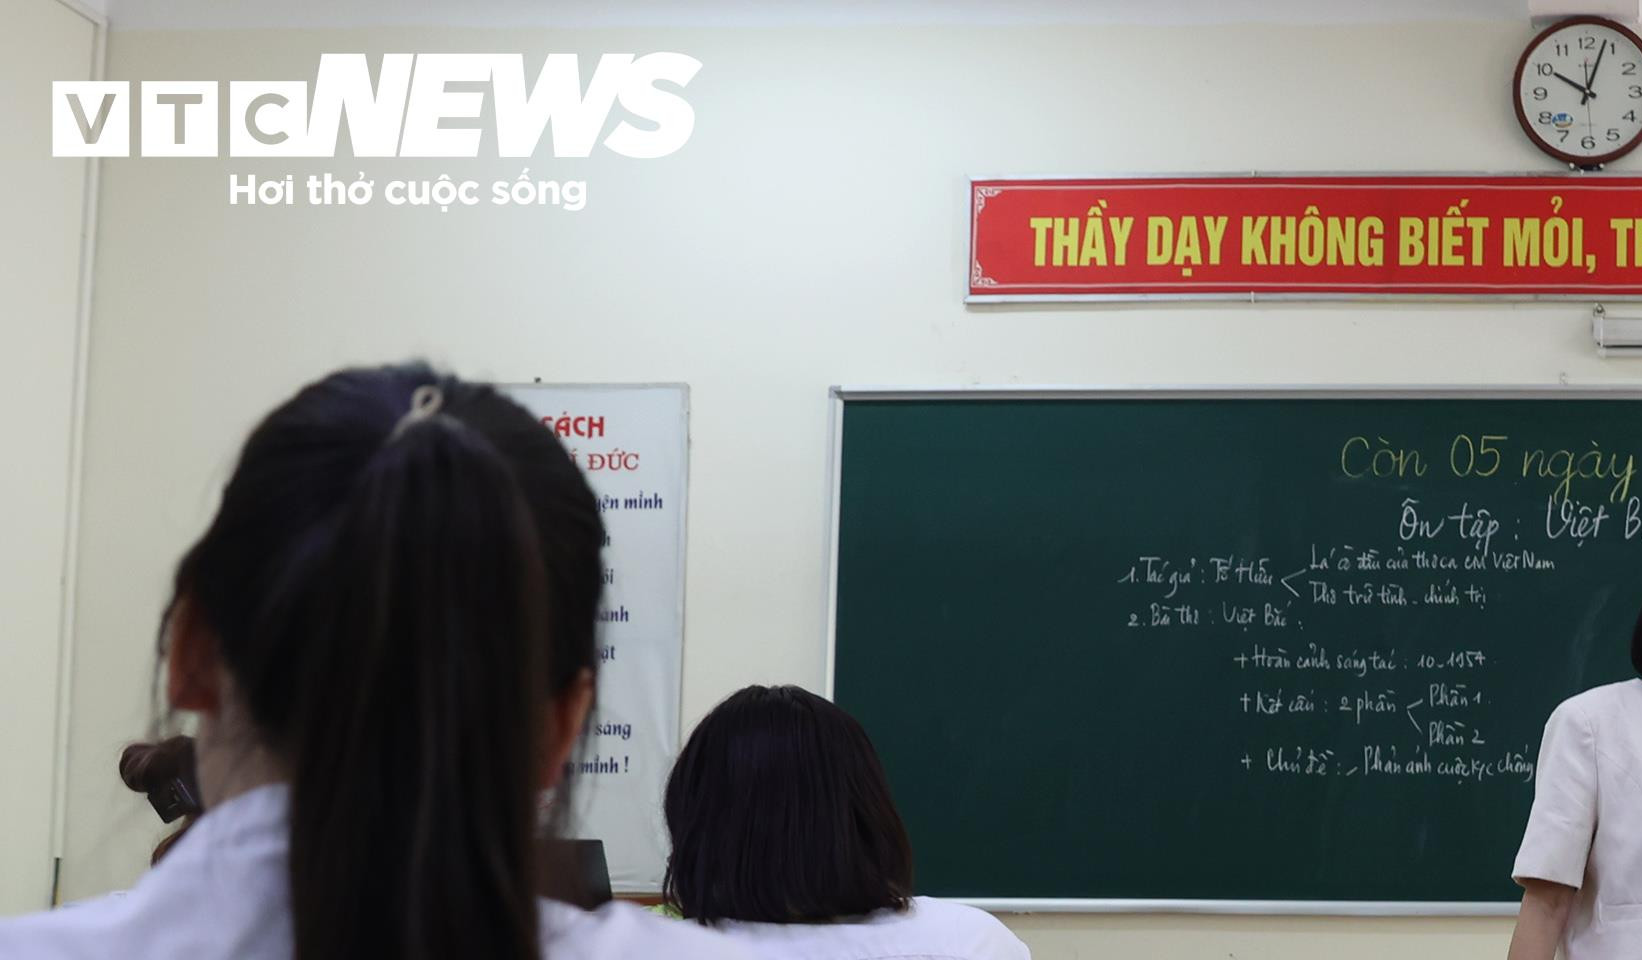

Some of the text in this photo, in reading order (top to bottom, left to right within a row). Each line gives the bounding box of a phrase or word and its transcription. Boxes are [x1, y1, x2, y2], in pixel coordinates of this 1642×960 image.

[1556, 44, 1569, 57] 11
[1578, 36, 1596, 50] 12
[1609, 42, 1616, 55] 1
[1536, 62, 1554, 77] 10
[1621, 62, 1637, 76] 2
[1532, 86, 1548, 101] 9
[1538, 111, 1552, 125] 8
[1621, 109, 1637, 123] 4
[1556, 129, 1570, 143] 7
[1580, 135, 1597, 150] 6
[1606, 128, 1621, 142] 5
[1030, 199, 1134, 267] THẦY
[1147, 215, 1228, 277] DẠY
[1241, 205, 1385, 267] KHÔNG
[1399, 198, 1490, 267] BIẾT
[1503, 195, 1597, 274] MỎI,
[587, 448, 640, 472] ĐỨC
[1342, 436, 1428, 479] Còn
[1450, 434, 1508, 478] 05
[1521, 440, 1637, 503] ngày
[1399, 497, 1444, 542] Ôn
[1448, 502, 1500, 555] tập
[1546, 494, 1610, 548] Việt
[1522, 549, 1556, 570] Nam
[1471, 728, 1485, 745] 2
